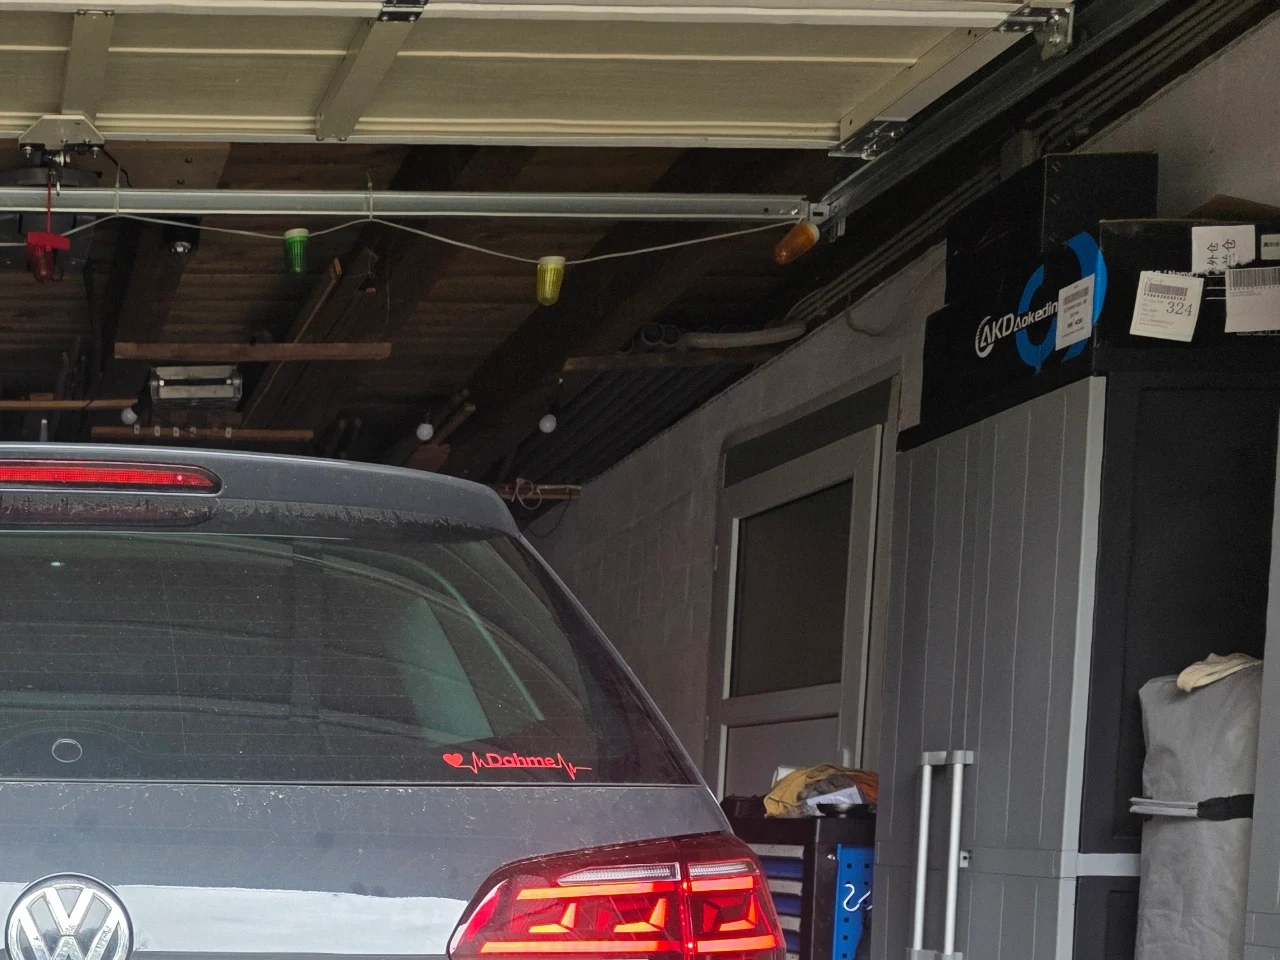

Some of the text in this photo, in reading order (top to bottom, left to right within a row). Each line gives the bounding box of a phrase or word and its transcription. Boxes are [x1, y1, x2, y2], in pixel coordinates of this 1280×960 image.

[1166, 301, 1193, 316] 324
[1013, 301, 1059, 334] Aokedin
[486, 752, 556, 767] Dahme
